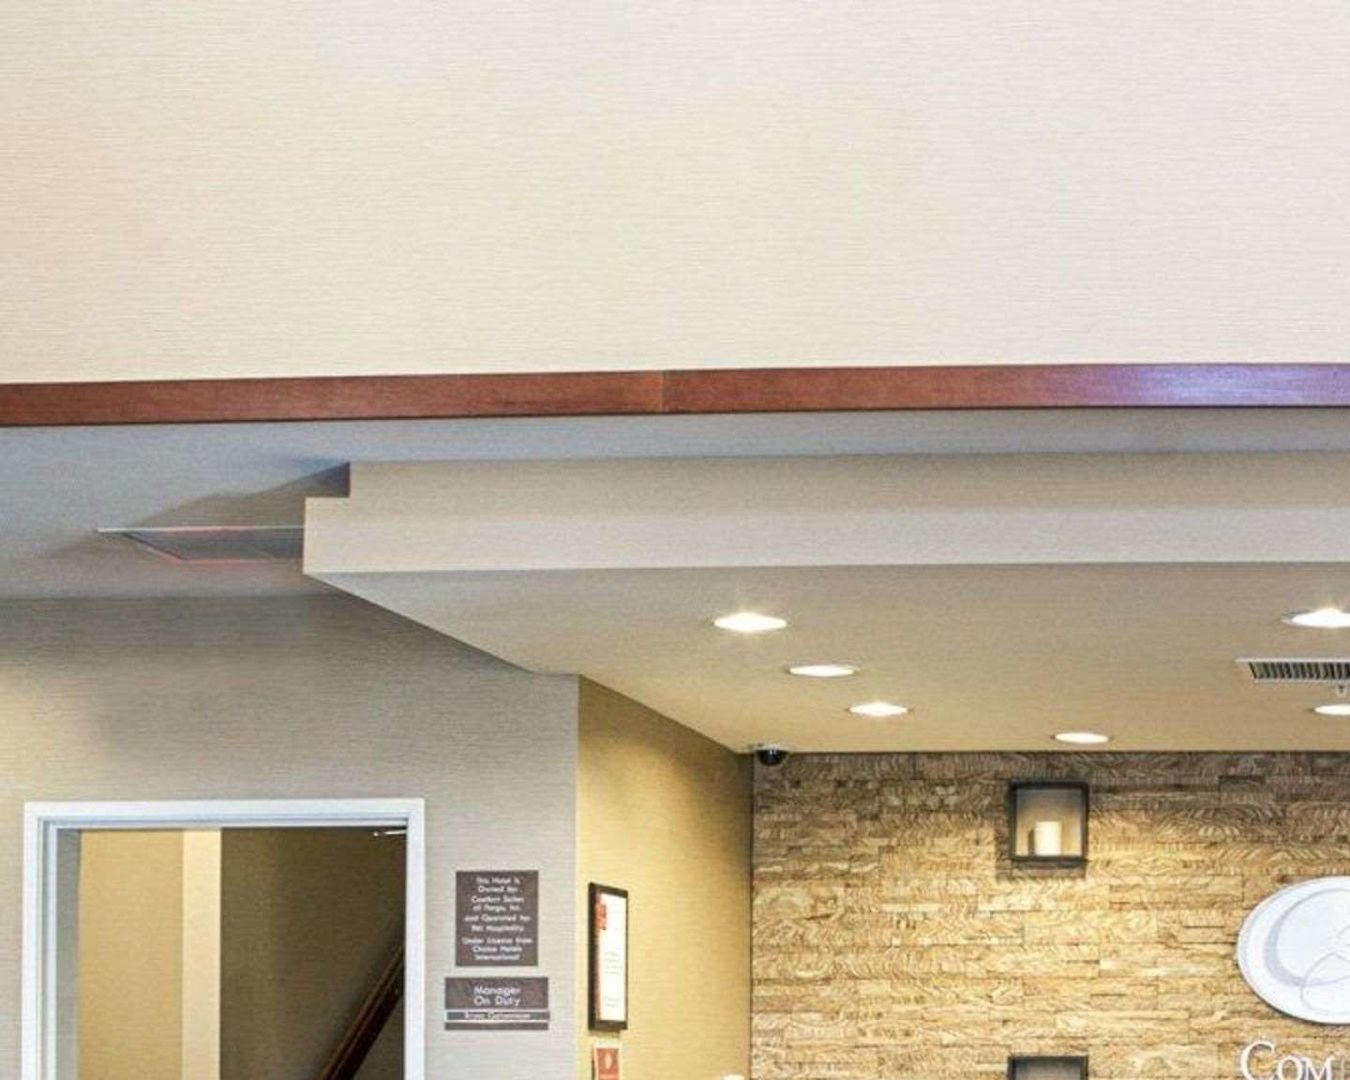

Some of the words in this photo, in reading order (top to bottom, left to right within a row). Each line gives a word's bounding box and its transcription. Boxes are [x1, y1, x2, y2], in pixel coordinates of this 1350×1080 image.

[473, 986, 521, 997] Manager
[473, 995, 491, 1007] On
[495, 995, 521, 1007] Duty
